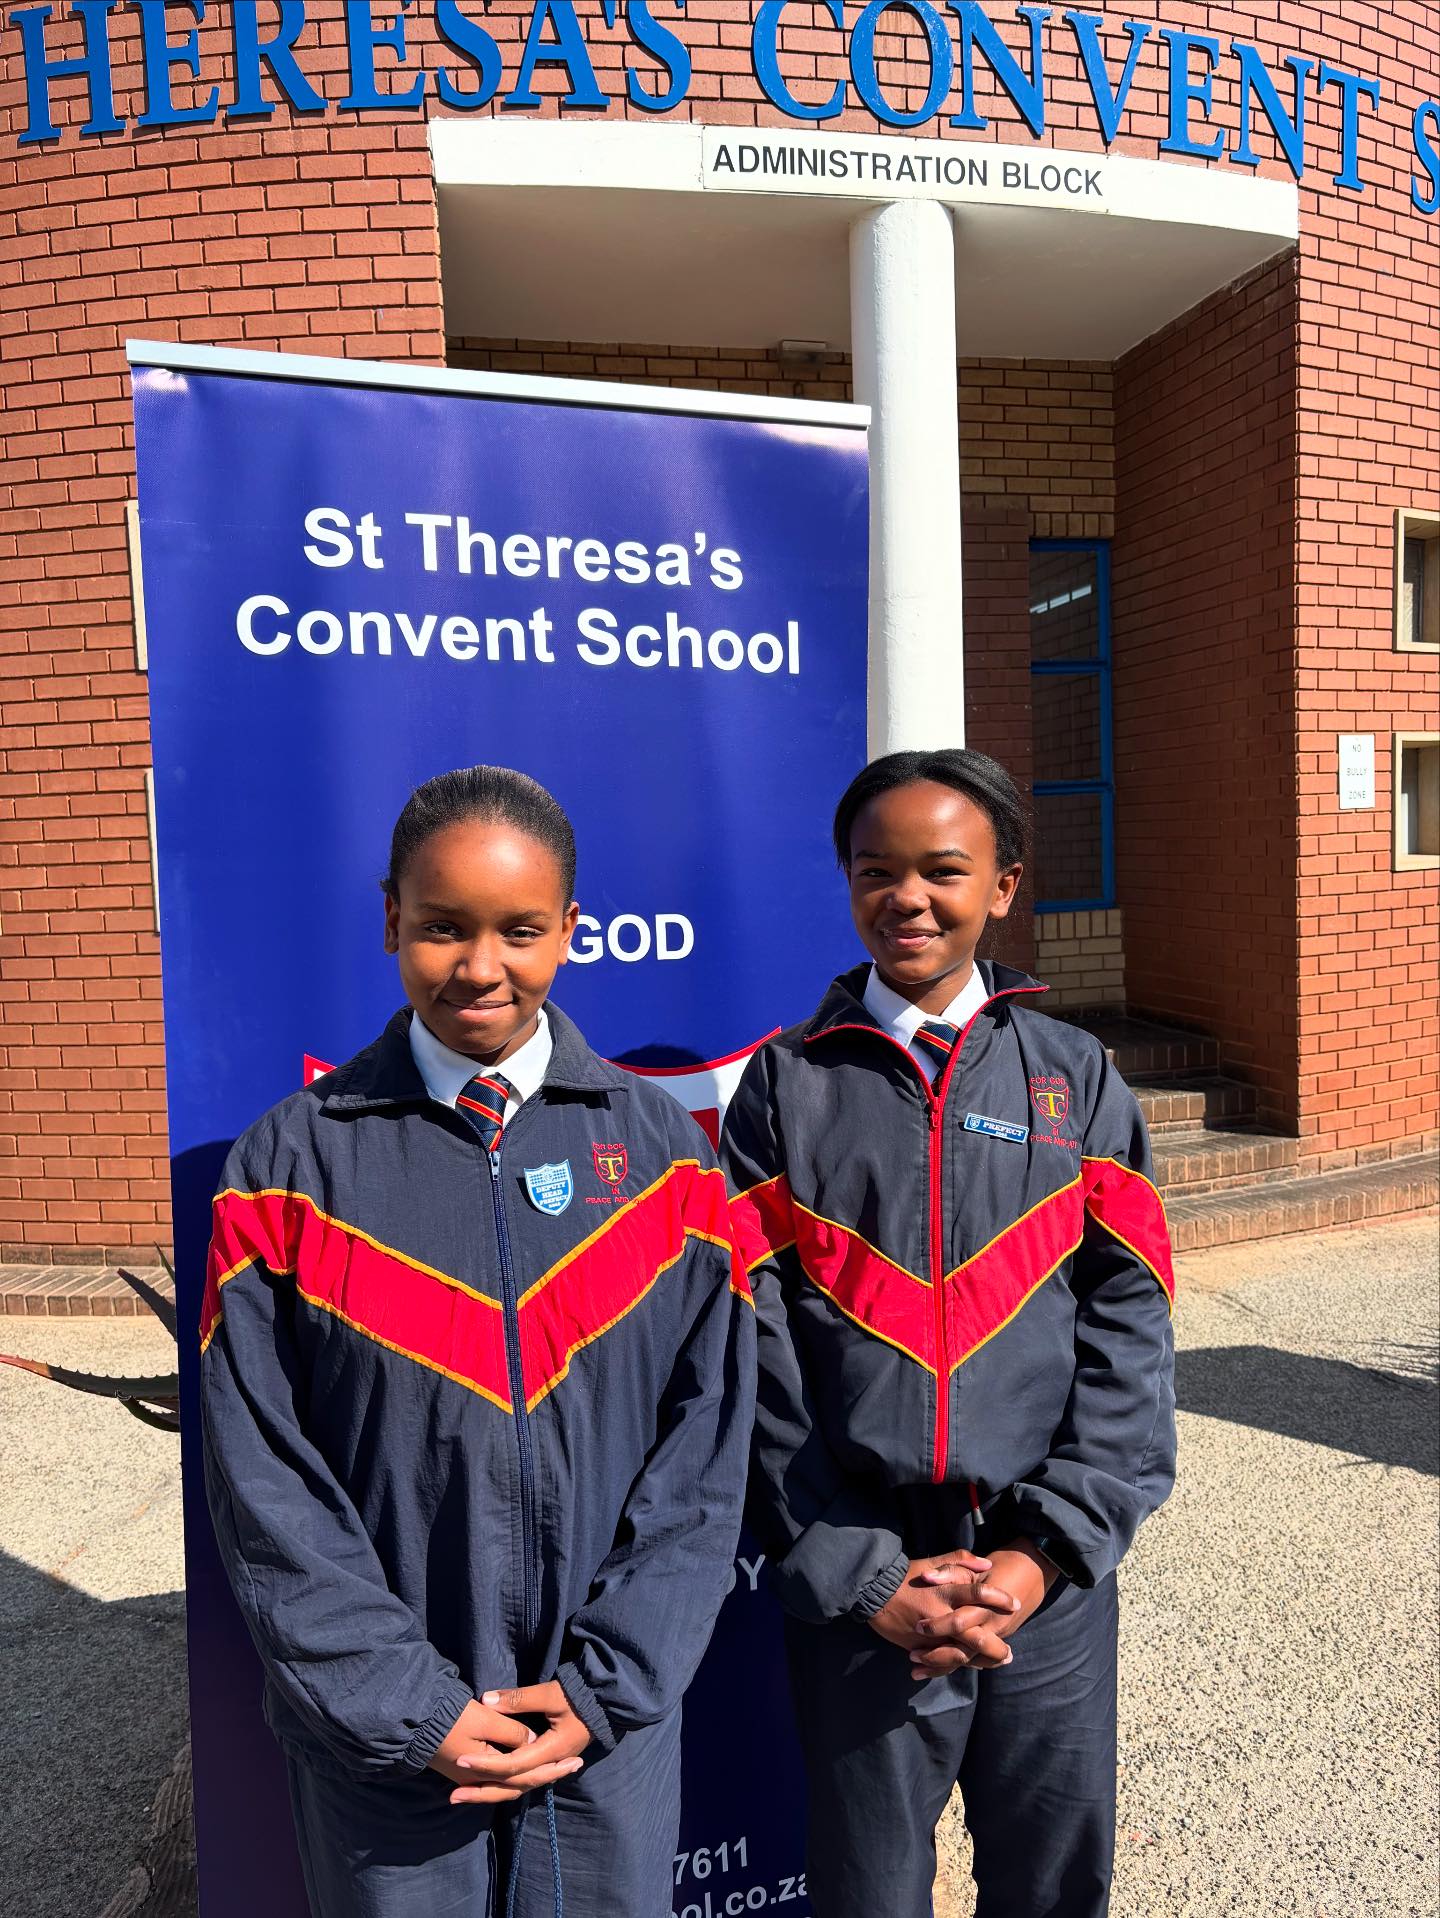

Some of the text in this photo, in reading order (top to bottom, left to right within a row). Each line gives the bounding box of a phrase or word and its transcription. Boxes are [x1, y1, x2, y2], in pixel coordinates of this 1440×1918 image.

[9, 0, 692, 142] HERESA'S
[751, 0, 1380, 192] CONVENT
[711, 145, 1104, 196] ADMINISTRATION BLOCK
[303, 507, 744, 590] St Theresa’s
[236, 595, 801, 675] Convent School
[566, 913, 695, 964] GOD
[1030, 1077, 1065, 1085] FOR GOD
[982, 1121, 1024, 1136] PREFECT
[535, 1182, 567, 1194] DEPUTY
[541, 1189, 563, 1199] HEAD
[726, 1554, 767, 1594] Y
[673, 1836, 748, 1886] 7611
[672, 1872, 808, 1918] ol.co.z
